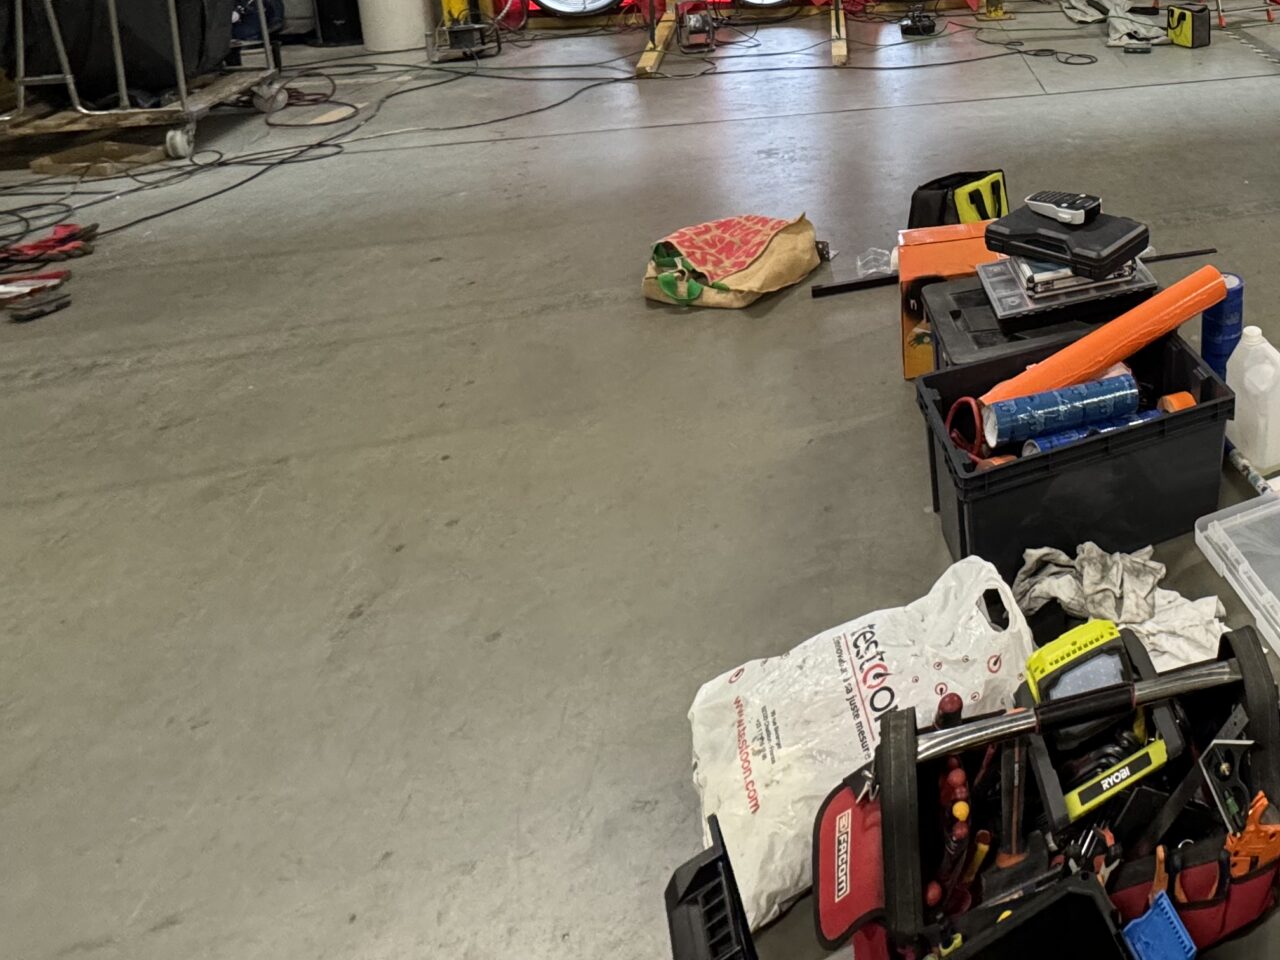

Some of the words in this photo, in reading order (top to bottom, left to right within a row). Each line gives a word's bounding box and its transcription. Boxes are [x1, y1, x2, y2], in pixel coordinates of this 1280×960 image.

[846, 694, 861, 720] juste
[855, 720, 872, 760] mesure
[1100, 766, 1131, 791] RYOBI
[838, 833, 848, 896] FACOM
